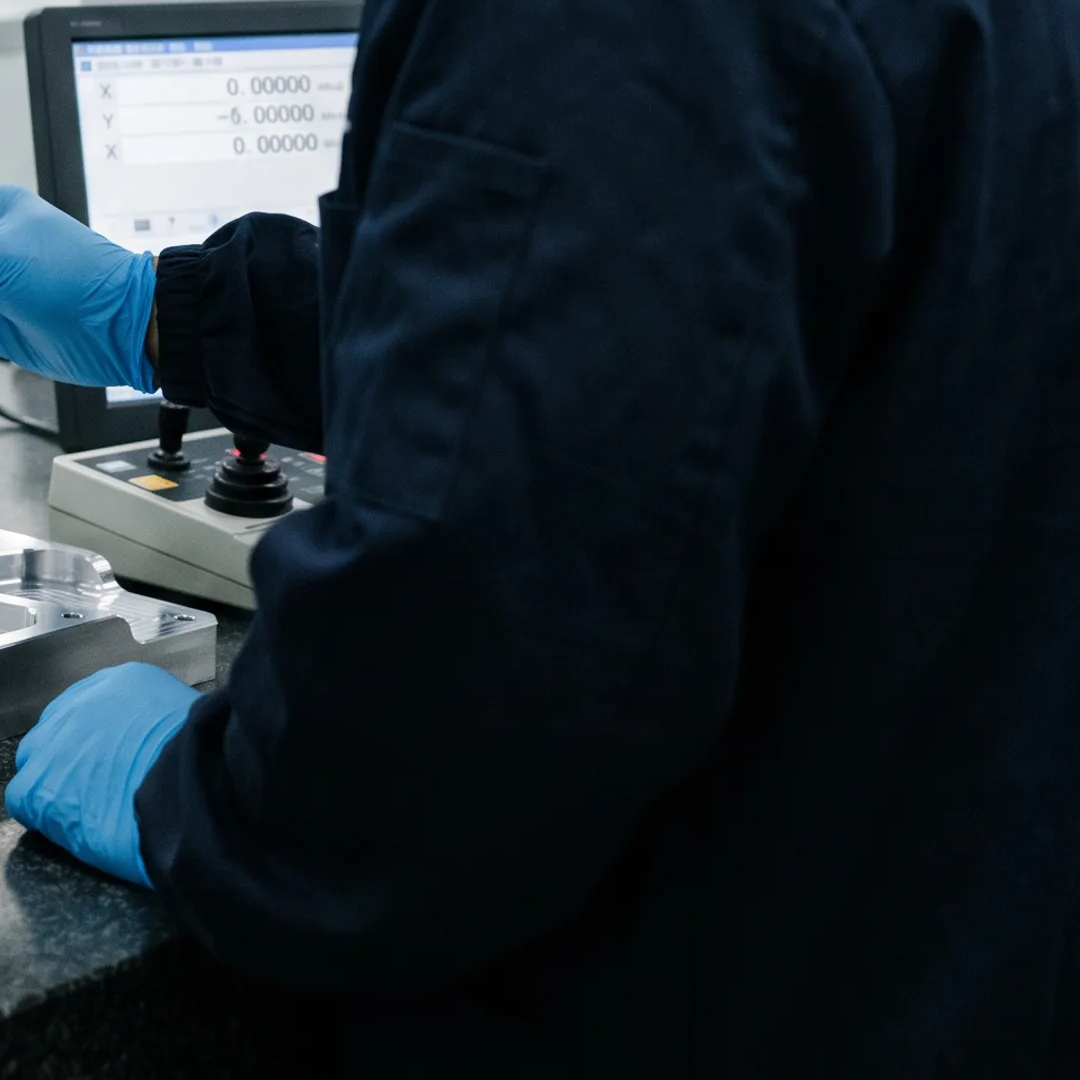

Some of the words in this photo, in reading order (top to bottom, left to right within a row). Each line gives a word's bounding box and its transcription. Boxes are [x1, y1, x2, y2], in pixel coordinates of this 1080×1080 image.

[100, 84, 112, 99] X
[103, 114, 113, 129] Y
[105, 144, 117, 159] X
